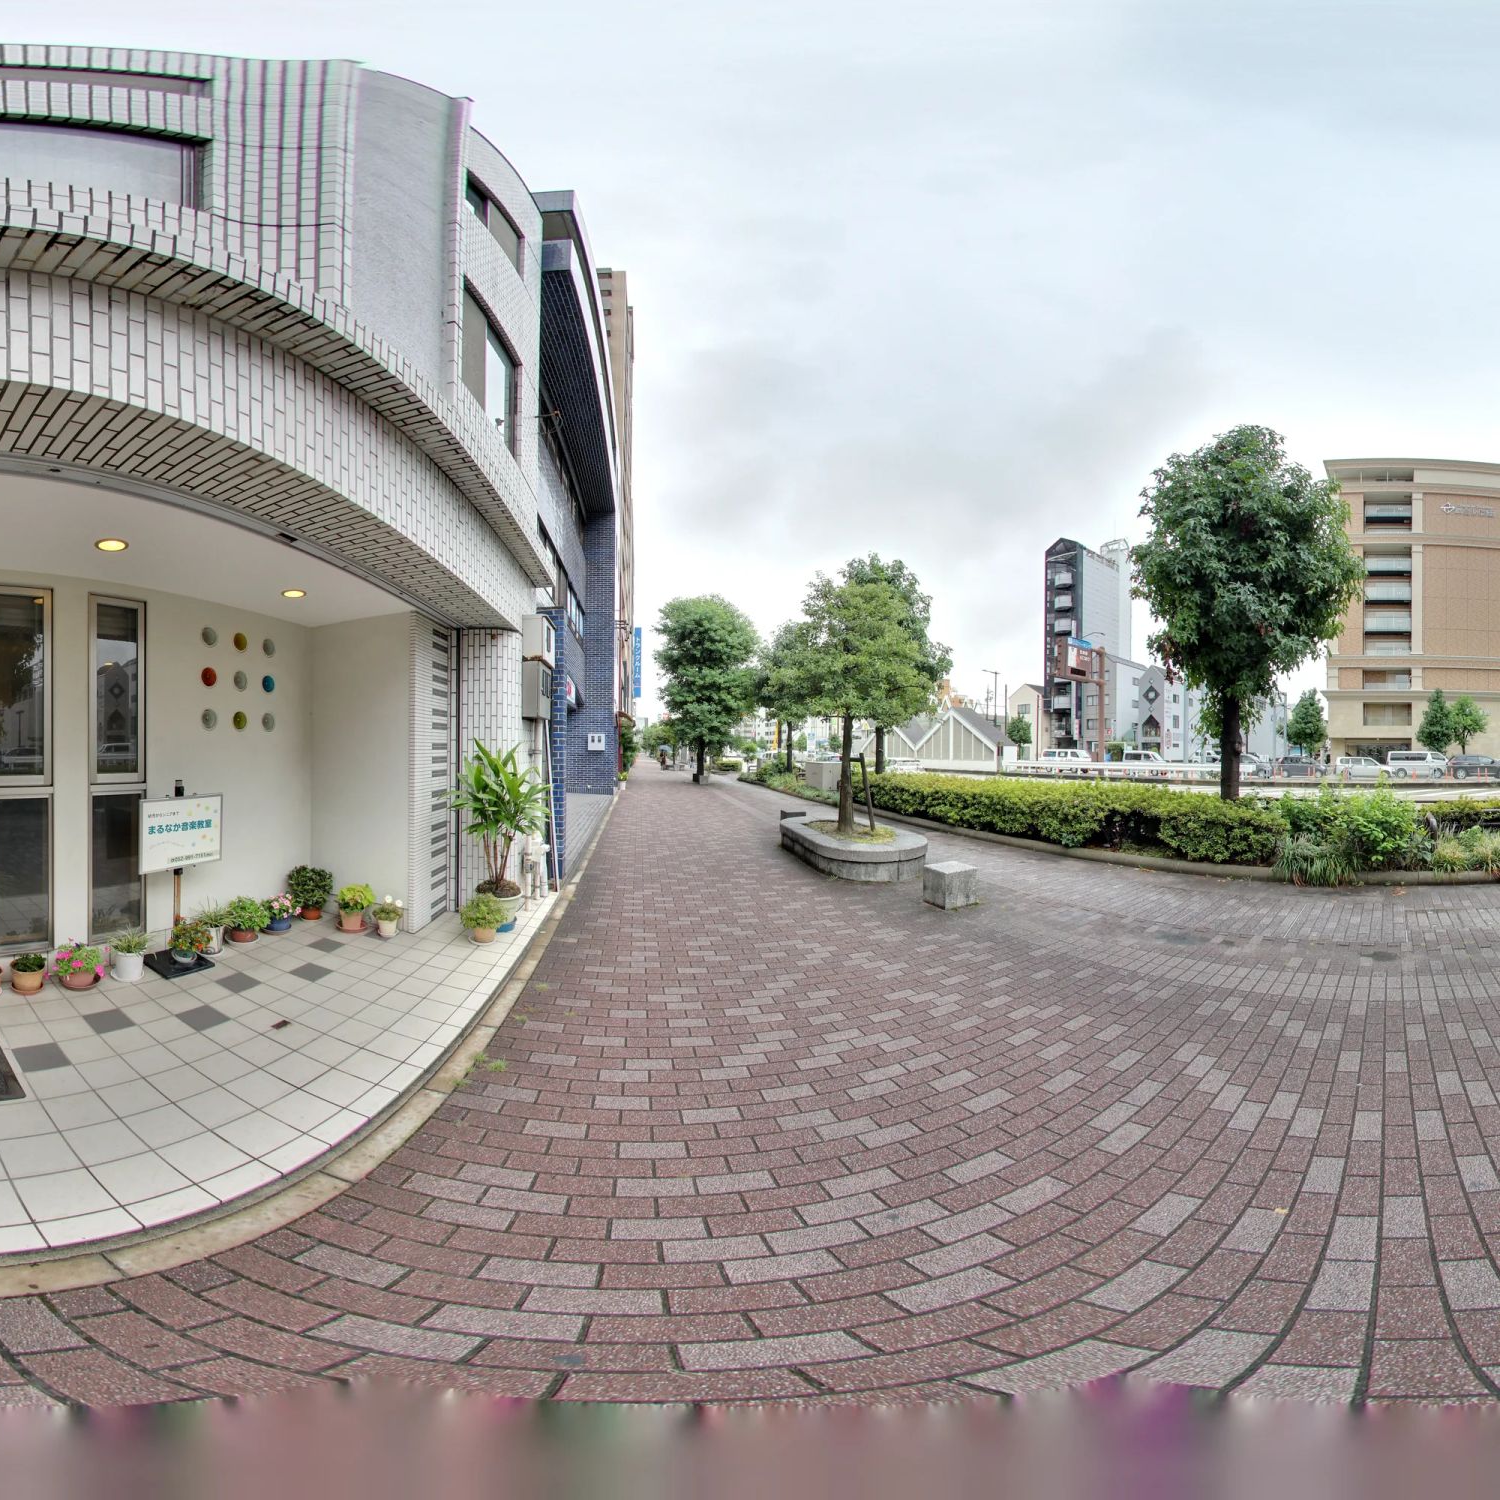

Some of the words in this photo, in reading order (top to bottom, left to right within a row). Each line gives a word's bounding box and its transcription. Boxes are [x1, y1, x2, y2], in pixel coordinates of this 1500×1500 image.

[148, 819, 212, 835] まるなか音楽教室
